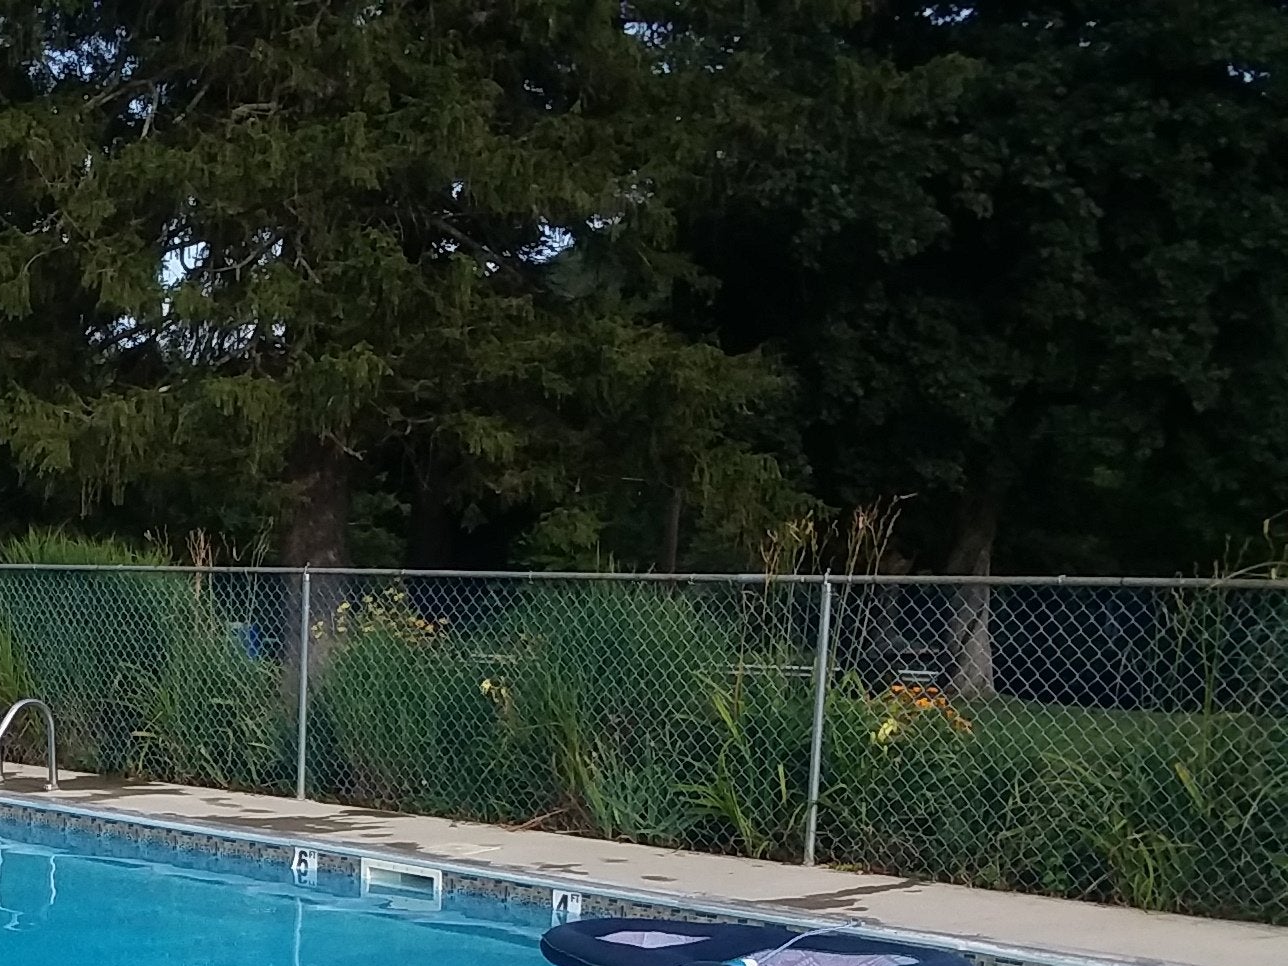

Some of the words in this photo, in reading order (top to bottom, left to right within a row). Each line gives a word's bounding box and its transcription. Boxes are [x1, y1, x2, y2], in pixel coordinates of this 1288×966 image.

[297, 850, 309, 870] 6
[556, 893, 569, 912] 4
[570, 893, 581, 903] FT
